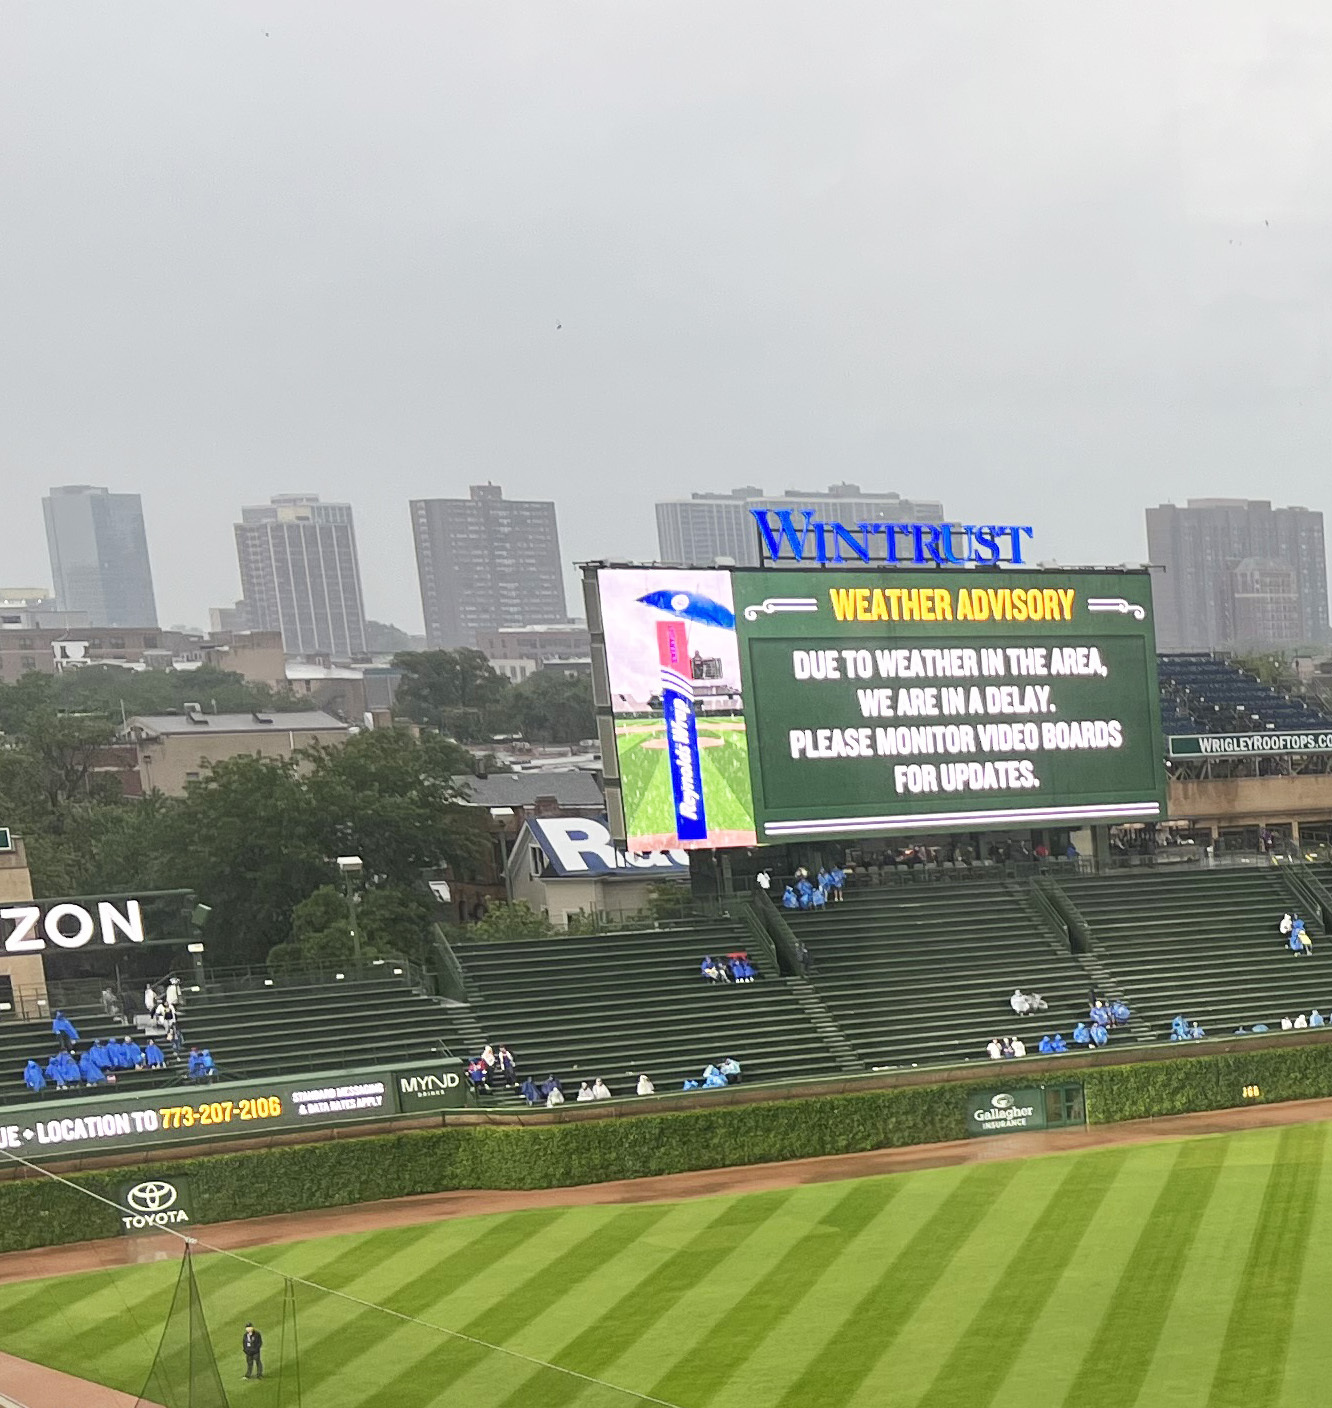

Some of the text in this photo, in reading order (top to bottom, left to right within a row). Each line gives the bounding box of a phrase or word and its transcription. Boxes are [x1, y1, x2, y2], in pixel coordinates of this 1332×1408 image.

[749, 508, 1034, 565] WINTRUST
[830, 588, 1075, 621] WEATHER ADVISORY
[793, 647, 1108, 680] DUE TO WEATHER IN THE AREA,
[857, 685, 1057, 718] WE ARE IN A DELAY.
[789, 720, 1123, 760] PLEASE MONITOR VIDEO BOARDS
[671, 696, 700, 821] Reynolds Wrap
[894, 761, 1041, 794] FOR UPDATES.
[0, 900, 144, 951] ZON
[401, 1073, 459, 1093] MYND
[36, 1114, 131, 1148] LOCATION
[133, 1111, 158, 1136] TO
[159, 1097, 282, 1133] 773-207-2106
[974, 1105, 1033, 1121] Gallagher
[982, 1117, 1027, 1130] INSURANCE
[122, 1209, 189, 1231] TOYOTA
